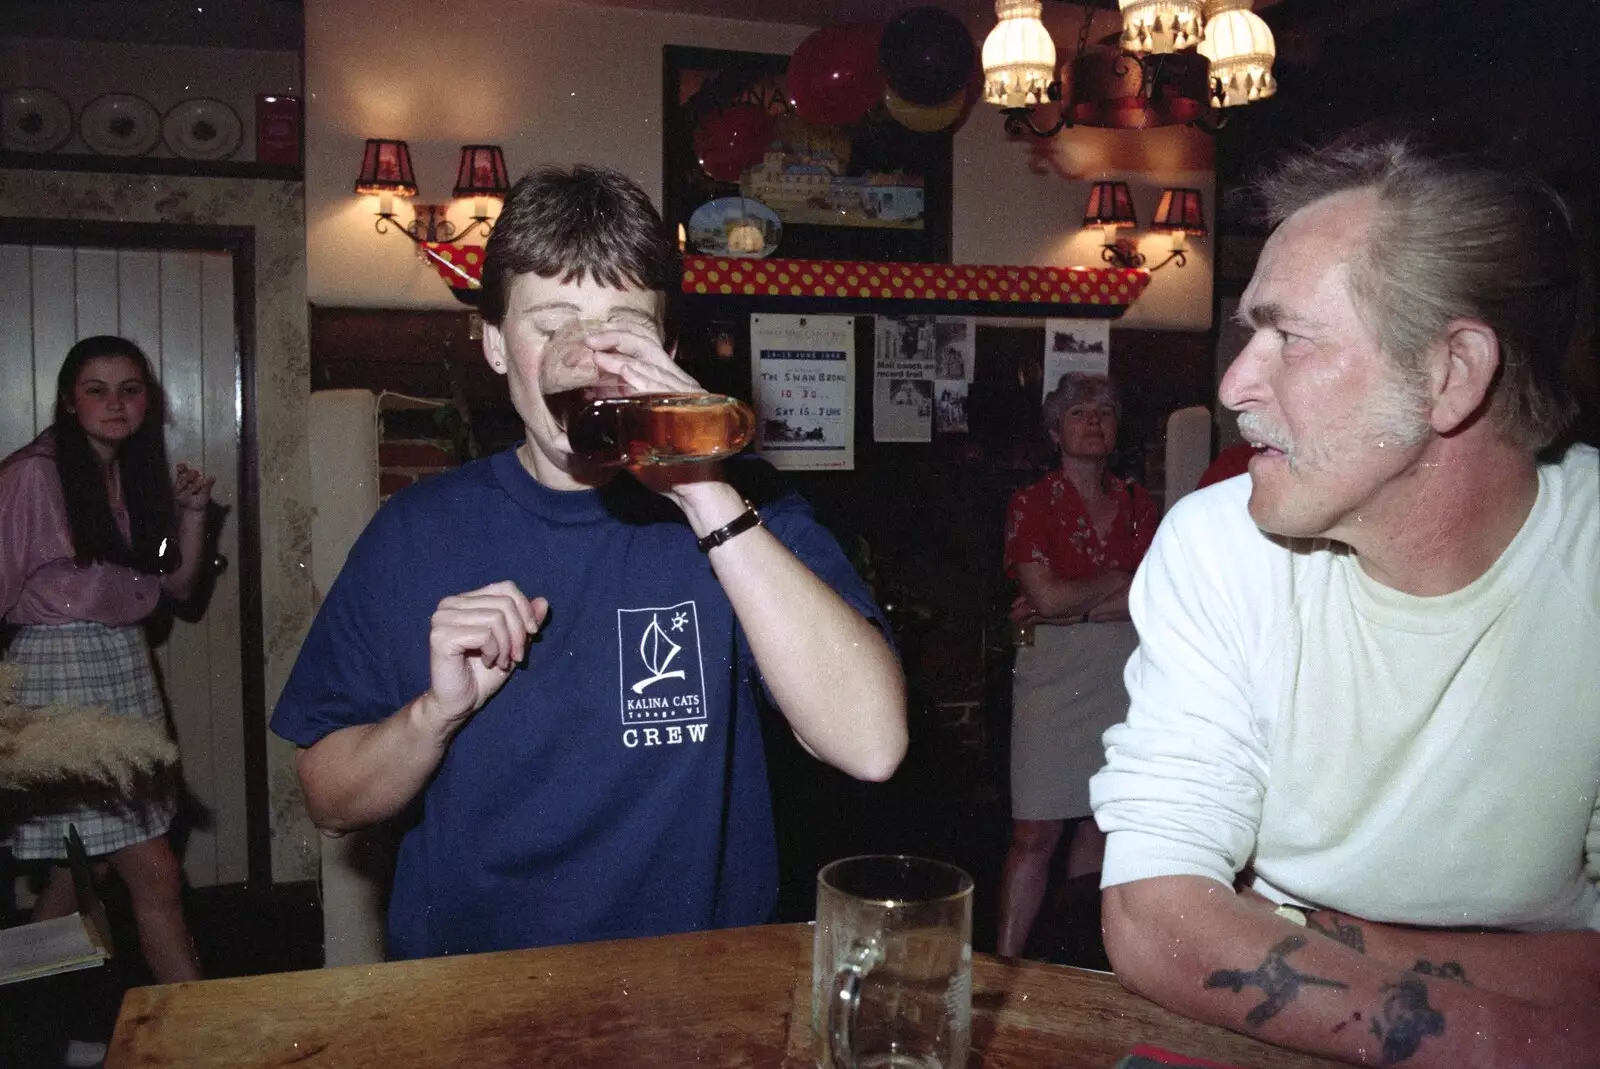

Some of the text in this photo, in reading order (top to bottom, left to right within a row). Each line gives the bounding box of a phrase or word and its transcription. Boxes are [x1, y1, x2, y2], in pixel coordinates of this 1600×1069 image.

[878, 361, 894, 369] Mail
[897, 362, 922, 370] coach
[784, 373, 816, 381] SWAN
[627, 694, 700, 710] KALINA CATS
[623, 724, 708, 747] CREW
